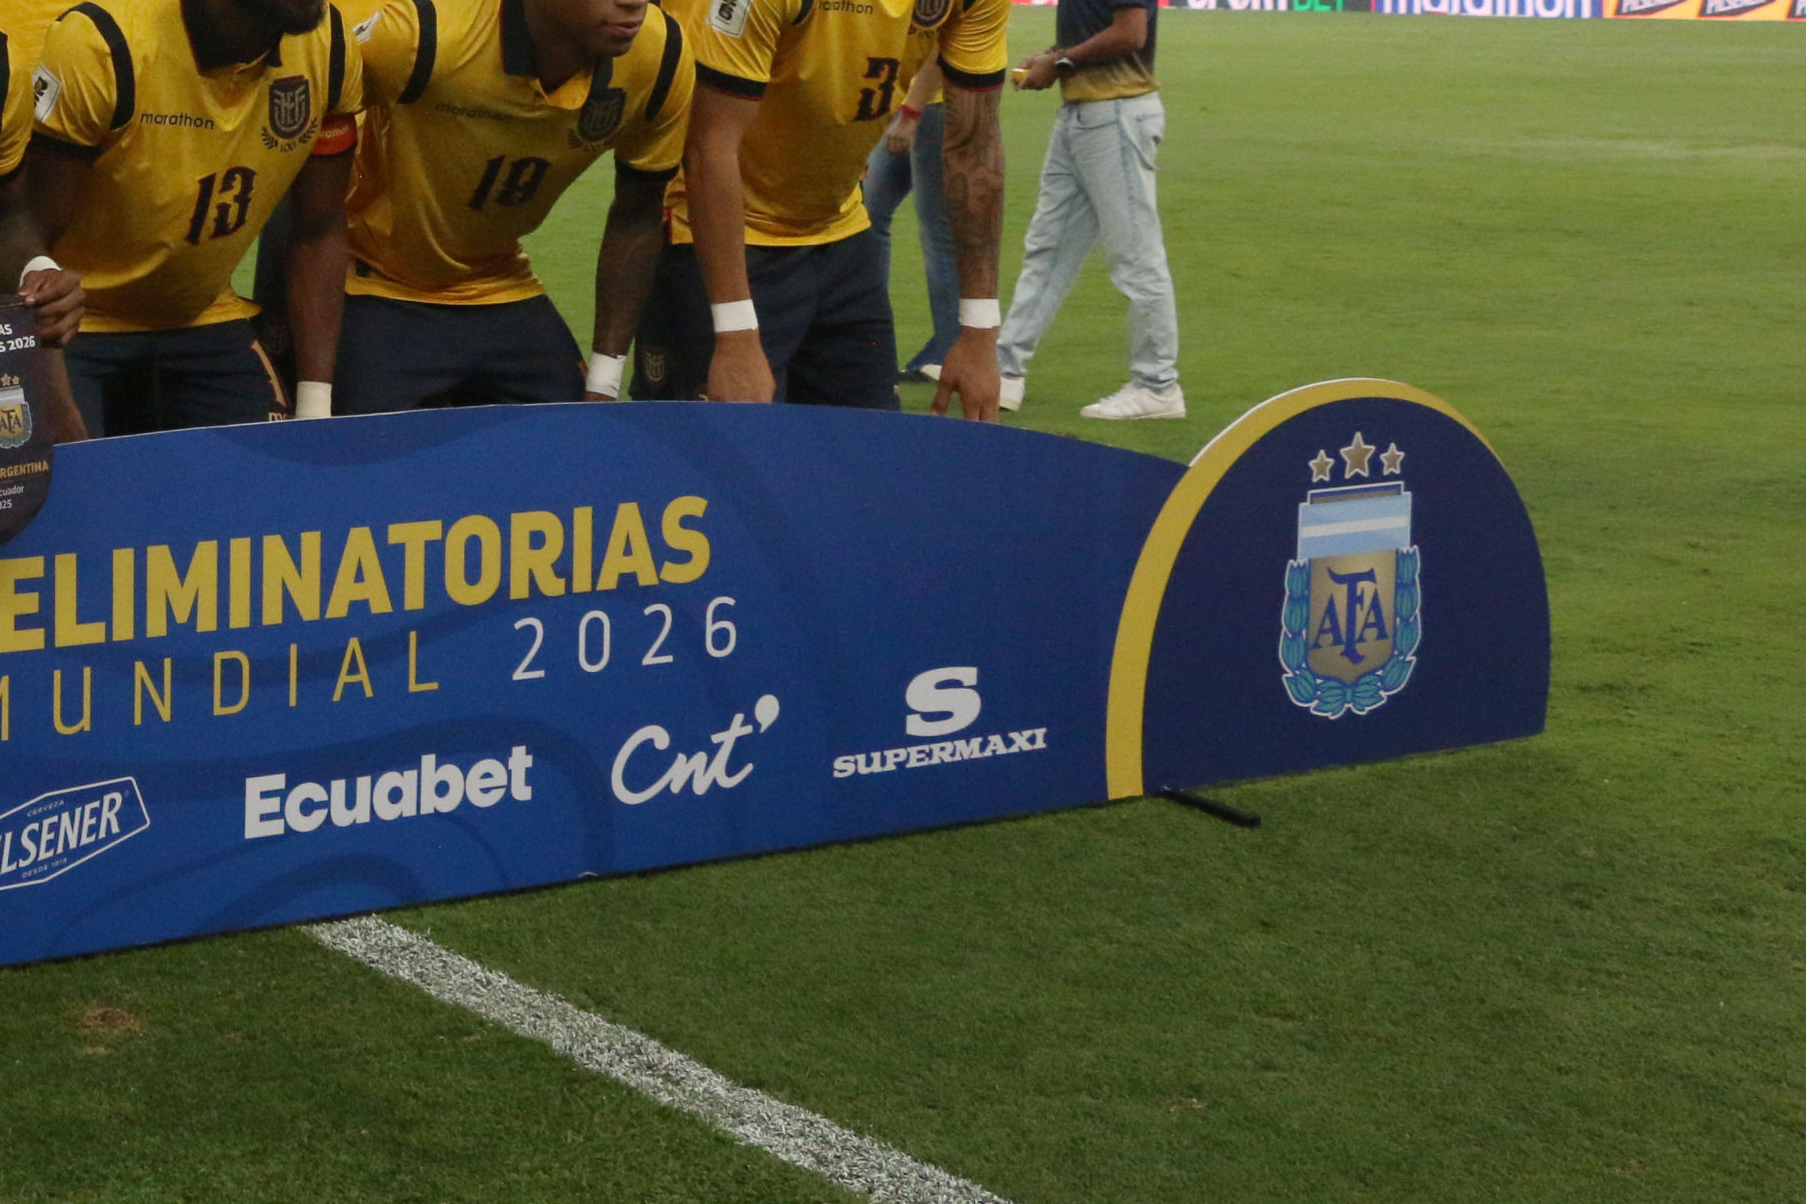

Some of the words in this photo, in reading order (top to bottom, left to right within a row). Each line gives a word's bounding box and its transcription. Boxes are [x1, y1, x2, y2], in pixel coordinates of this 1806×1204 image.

[140, 112, 215, 130] marathon
[855, 57, 900, 123] 3
[184, 165, 257, 246] 13
[8, 336, 36, 351] 2026
[512, 596, 738, 682] 2026
[1310, 566, 1390, 665] AFA
[832, 728, 1047, 779] SUPERMAXI
[27, 799, 65, 817] CERVEZA
[243, 745, 534, 840] Ecuabet
